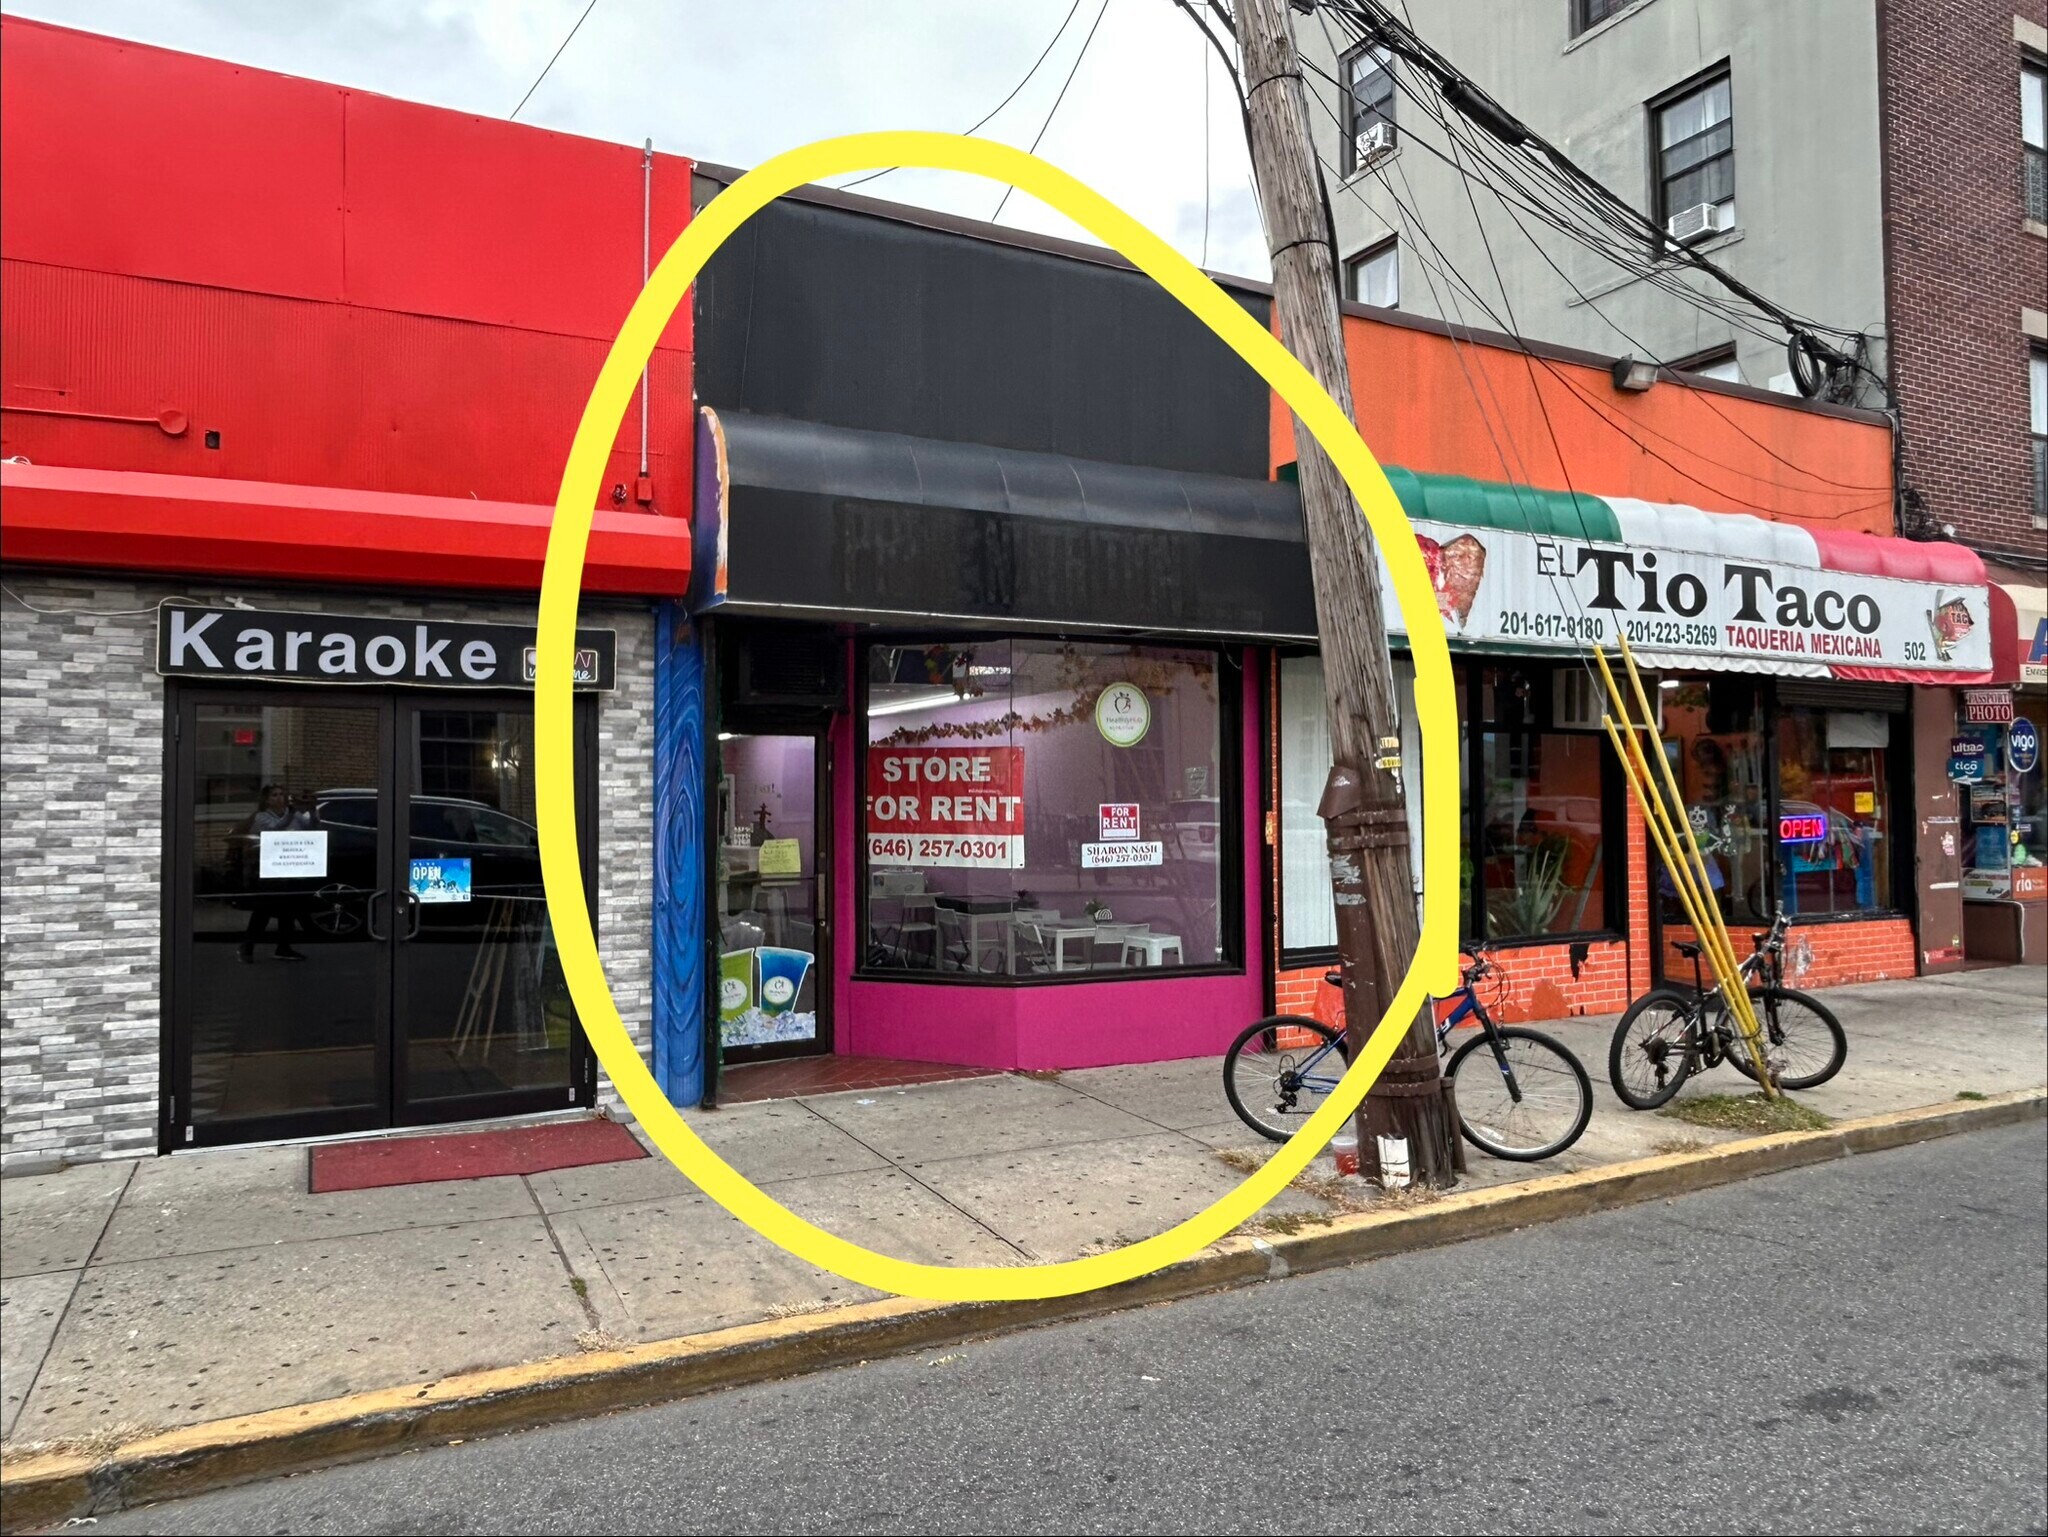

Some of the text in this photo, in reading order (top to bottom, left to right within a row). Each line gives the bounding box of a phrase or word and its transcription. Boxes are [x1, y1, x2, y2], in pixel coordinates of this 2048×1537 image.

[1537, 543, 1881, 634] EL Tio Taco
[1500, 611, 1603, 639] 201-617-0180
[1627, 620, 1717, 646] 201-223-5269
[169, 610, 497, 680] Karaoke
[1725, 625, 1882, 658] TAQUERIA MEXICANA
[1905, 642, 1926, 661] 502
[1968, 705, 2010, 720] PHOTO
[2011, 731, 2035, 751] vigo
[883, 757, 991, 782] STORE
[931, 796, 1021, 822] RENT
[1111, 807, 1130, 817] FOR
[1103, 817, 1136, 829] RENT
[1780, 818, 1823, 839] OPEN
[868, 839, 1006, 861] (646) 257-0301
[1087, 845, 1157, 856] SHARON NASH
[1091, 854, 1152, 864] (646) 257-0301
[413, 866, 441, 880] OPEN
